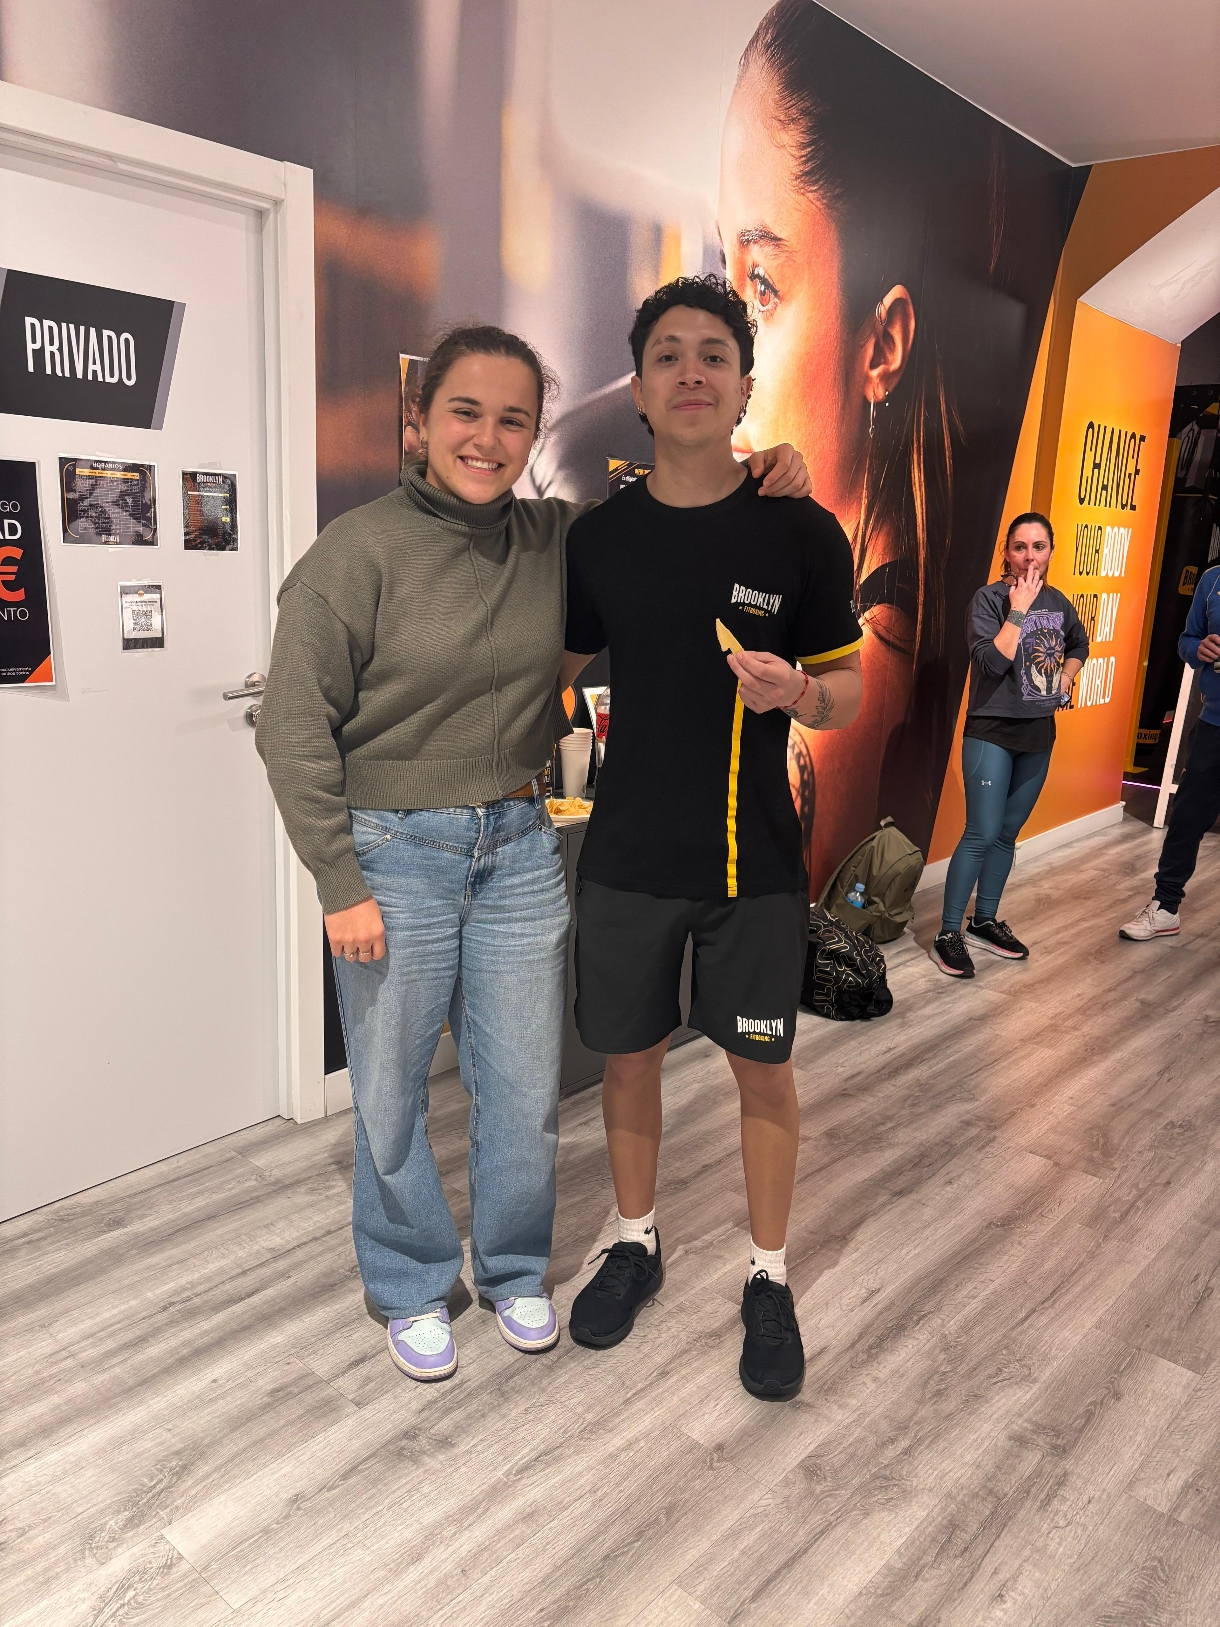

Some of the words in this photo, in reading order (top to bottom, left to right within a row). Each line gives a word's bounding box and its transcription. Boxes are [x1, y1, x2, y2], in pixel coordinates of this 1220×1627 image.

[24, 315, 137, 386] PRIVADO
[196, 473, 223, 485] BROOKLYN
[1078, 420, 1147, 511] CHANGE
[0, 518, 23, 540] D
[1073, 523, 1103, 577] YOUR
[1100, 525, 1132, 578] BODY
[730, 582, 783, 615] BROOKLYN
[1096, 592, 1121, 643] DAY
[1078, 656, 1116, 709] WORLD
[736, 1015, 784, 1038] BROOKLYN
